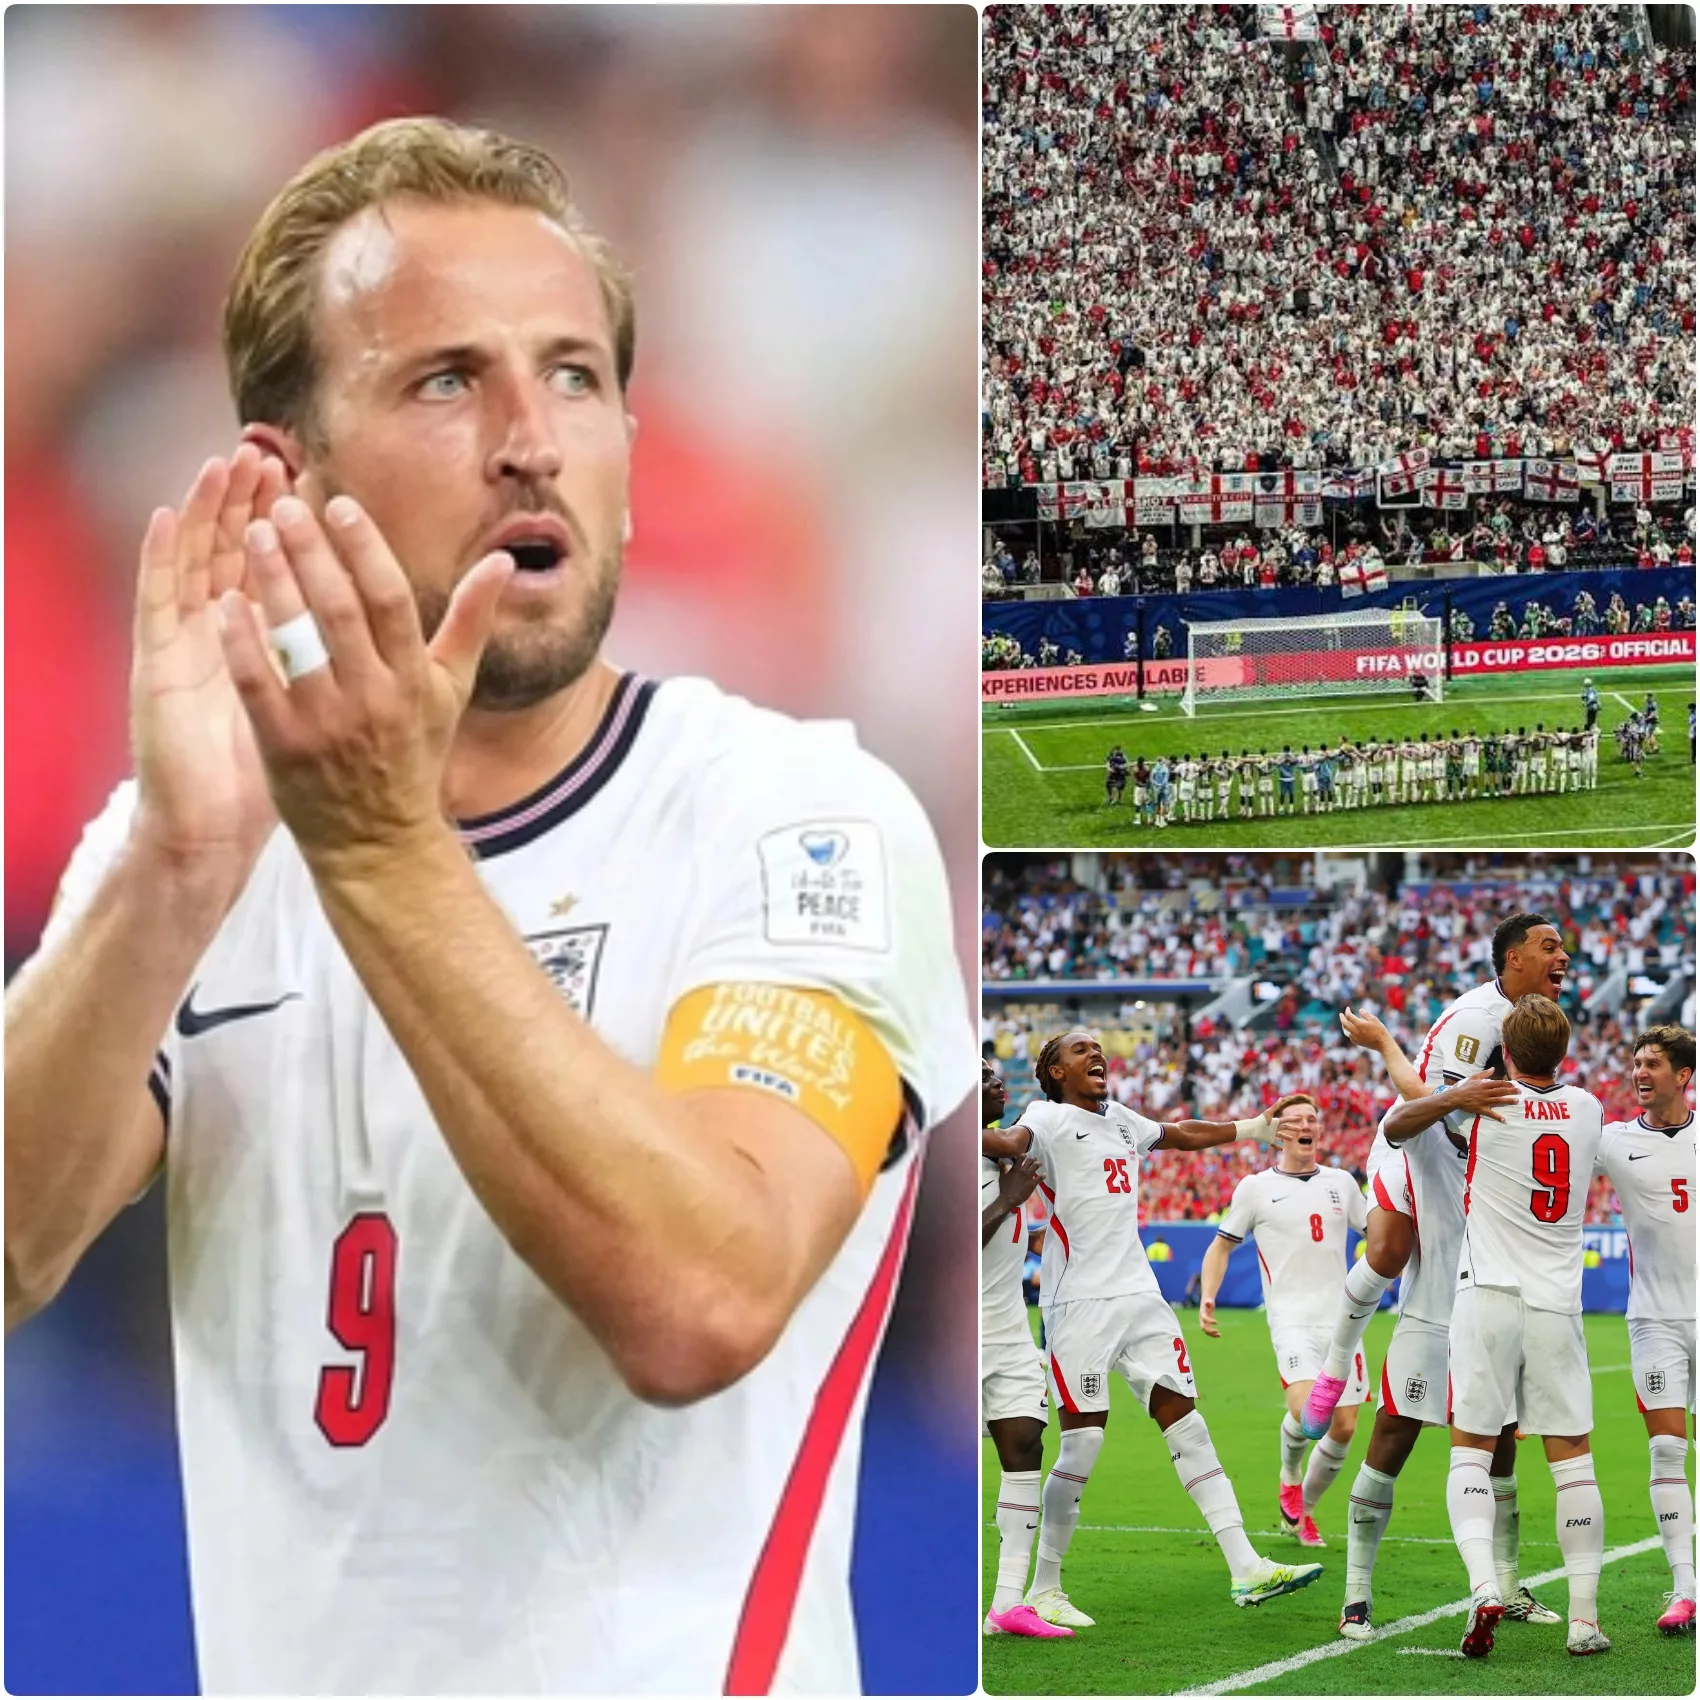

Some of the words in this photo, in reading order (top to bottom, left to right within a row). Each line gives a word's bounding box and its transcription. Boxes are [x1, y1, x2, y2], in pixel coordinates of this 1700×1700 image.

[1356, 654, 1401, 673] FIFA
[1482, 648, 1525, 666] CUP
[1610, 638, 1694, 659] OFFICIAL
[981, 673, 1098, 696] XPERIENCES
[1102, 666, 1205, 688] AVALABLE
[798, 891, 861, 923] PEACE
[712, 983, 856, 1048] FOOTBALL
[700, 1003, 857, 1083] UNITES
[735, 1067, 795, 1096] FIFA
[1524, 1100, 1571, 1121] KANE
[1103, 1158, 1132, 1194] 25
[1530, 1133, 1571, 1223] 9
[1671, 1178, 1689, 1213] 5
[1310, 1213, 1324, 1242] 8
[1582, 1231, 1628, 1259] FIF
[313, 1212, 399, 1448] 9
[1172, 1337, 1191, 1374] 2
[1171, 1451, 1181, 1463] EN
[1463, 1486, 1489, 1496] ENG
[1565, 1517, 1592, 1528] ENG
[1659, 1511, 1679, 1523] ENG
